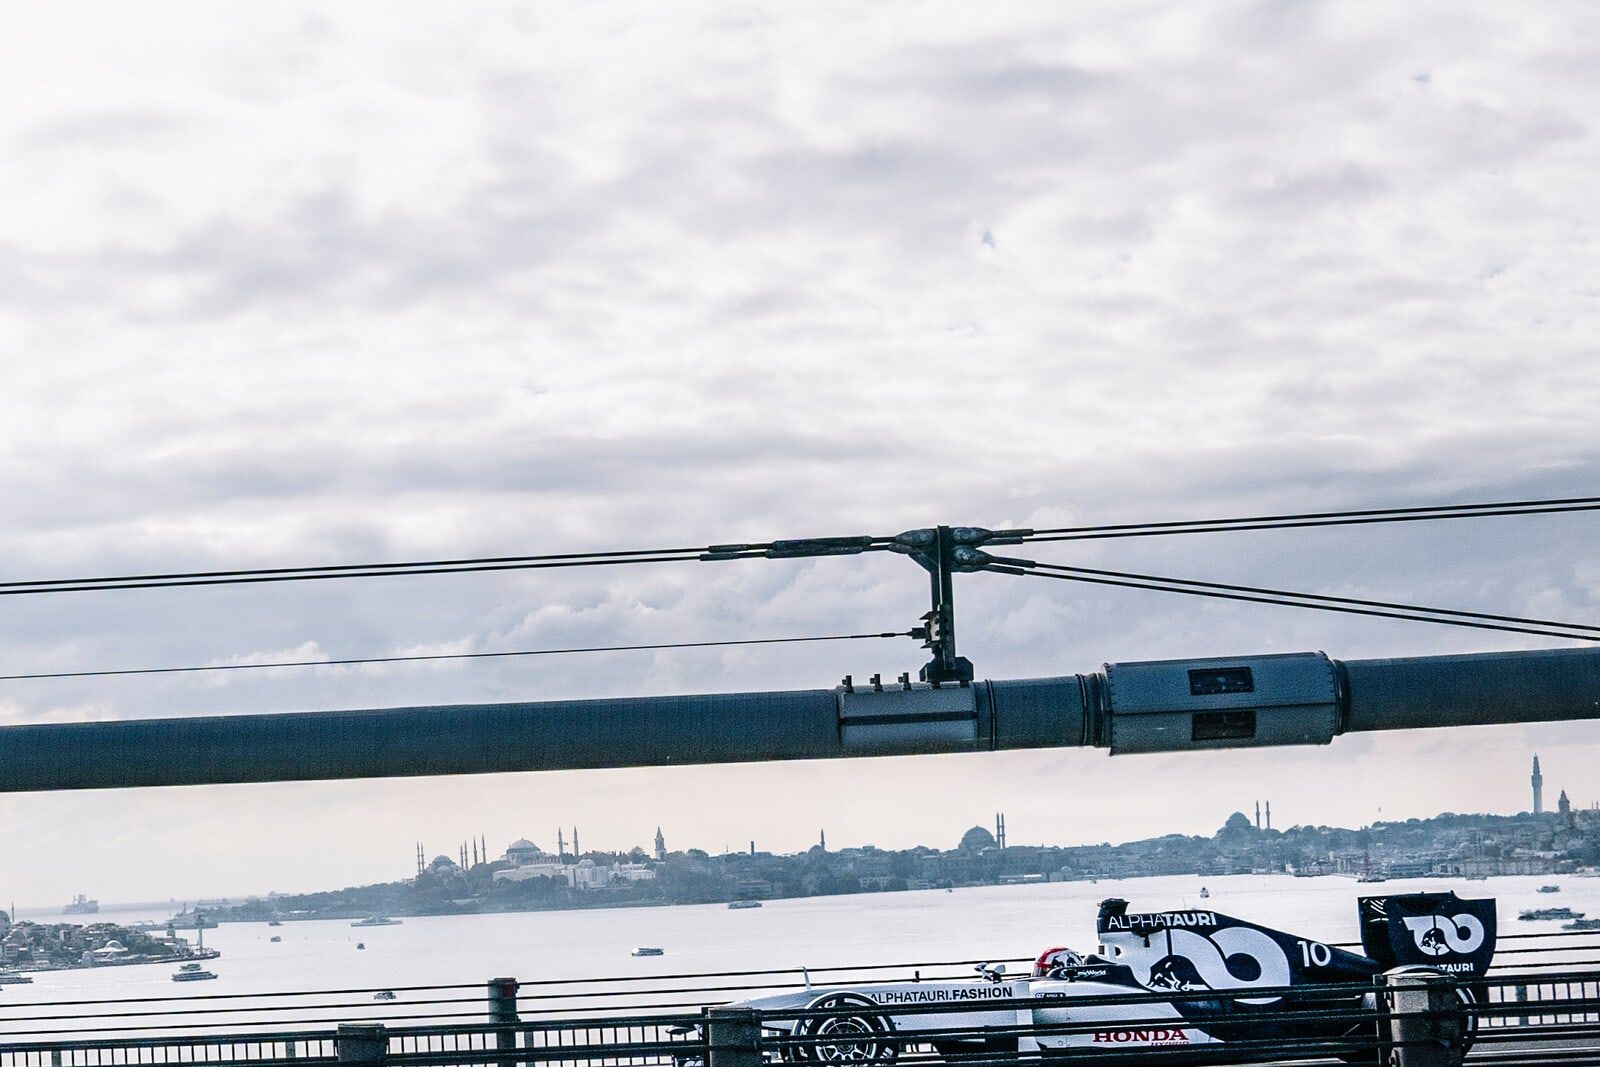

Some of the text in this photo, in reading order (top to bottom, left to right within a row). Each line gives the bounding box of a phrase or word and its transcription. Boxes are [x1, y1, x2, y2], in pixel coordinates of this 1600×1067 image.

[1107, 912, 1217, 930] ALPHATAURI
[1296, 940, 1332, 968] 10
[1092, 1028, 1189, 1043] HONDA
